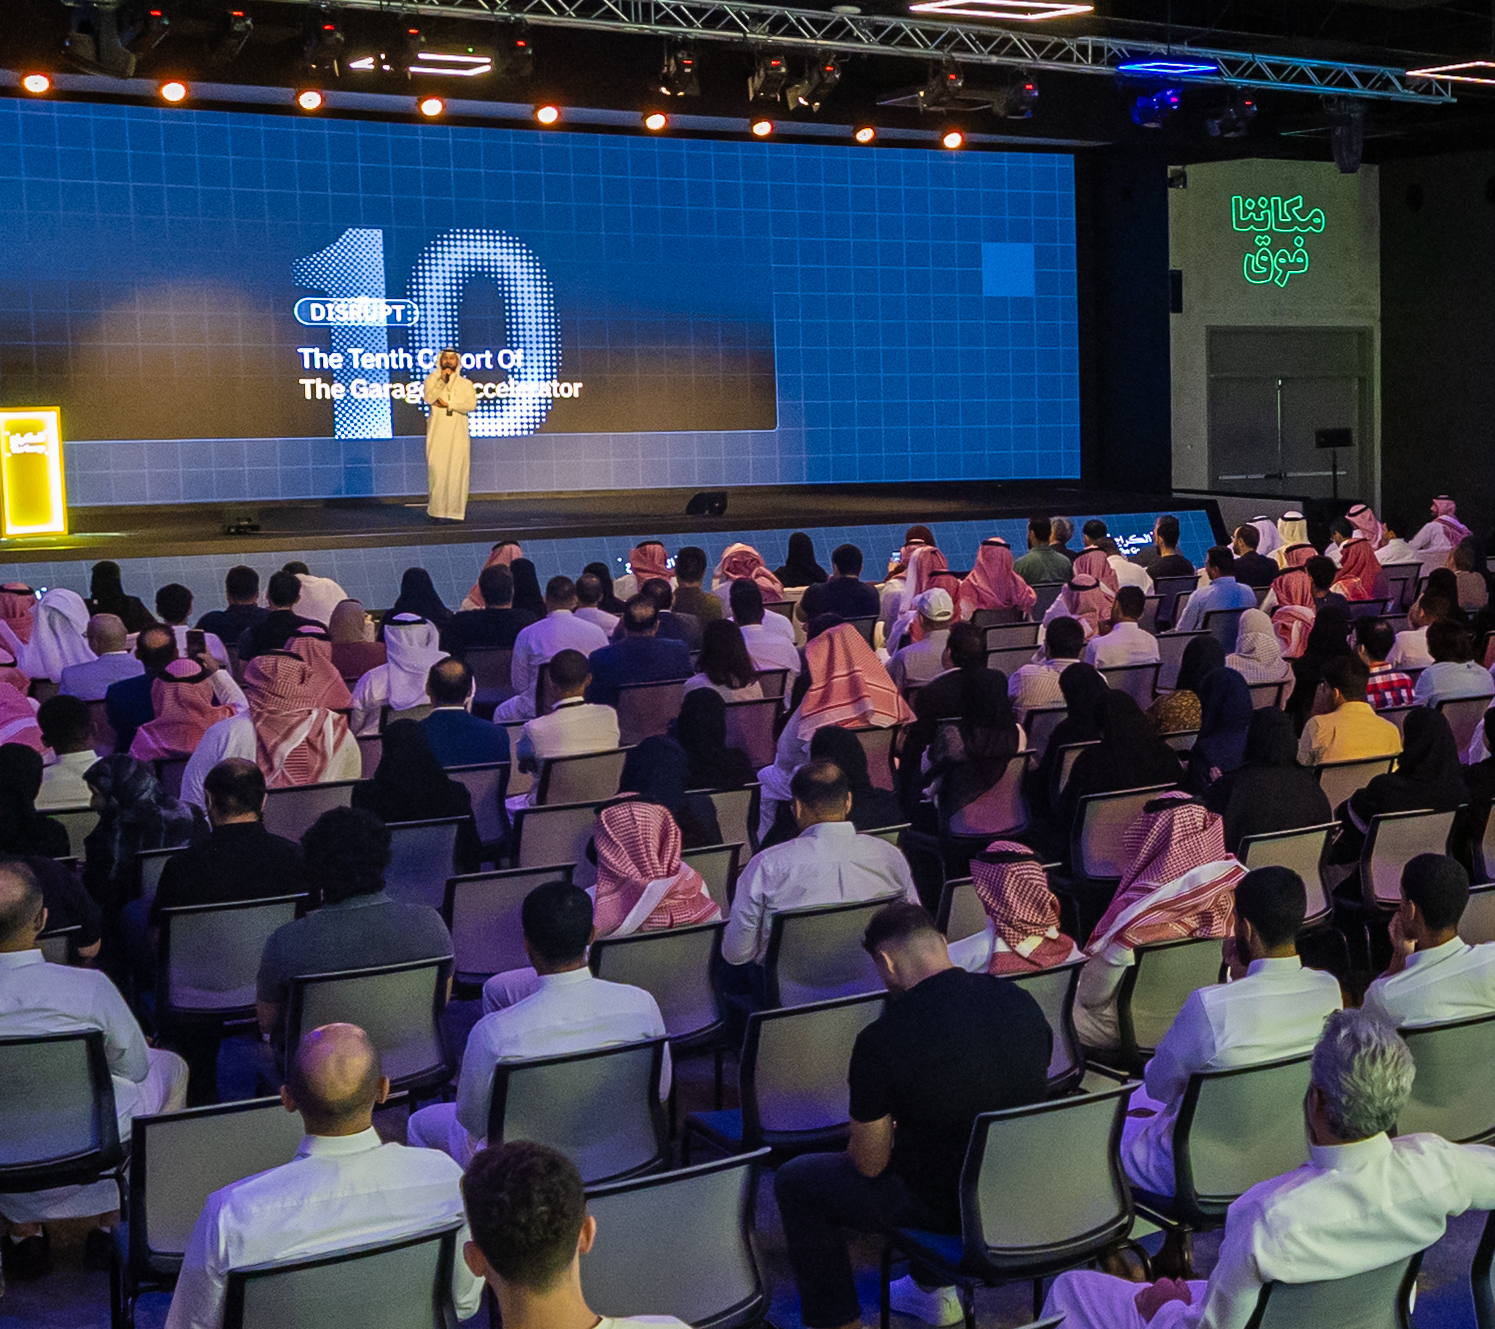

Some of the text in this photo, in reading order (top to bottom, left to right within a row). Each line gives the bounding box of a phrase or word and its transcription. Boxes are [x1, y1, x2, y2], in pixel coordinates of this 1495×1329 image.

[1231, 194, 1326, 233] مكاننا
[1243, 234, 1309, 288] فوق
[309, 302, 406, 322] DISRUPT
[292, 227, 562, 439] 10
[296, 347, 524, 370] The Tenth Cort Of
[298, 377, 345, 400] The
[349, 377, 425, 404] Garag
